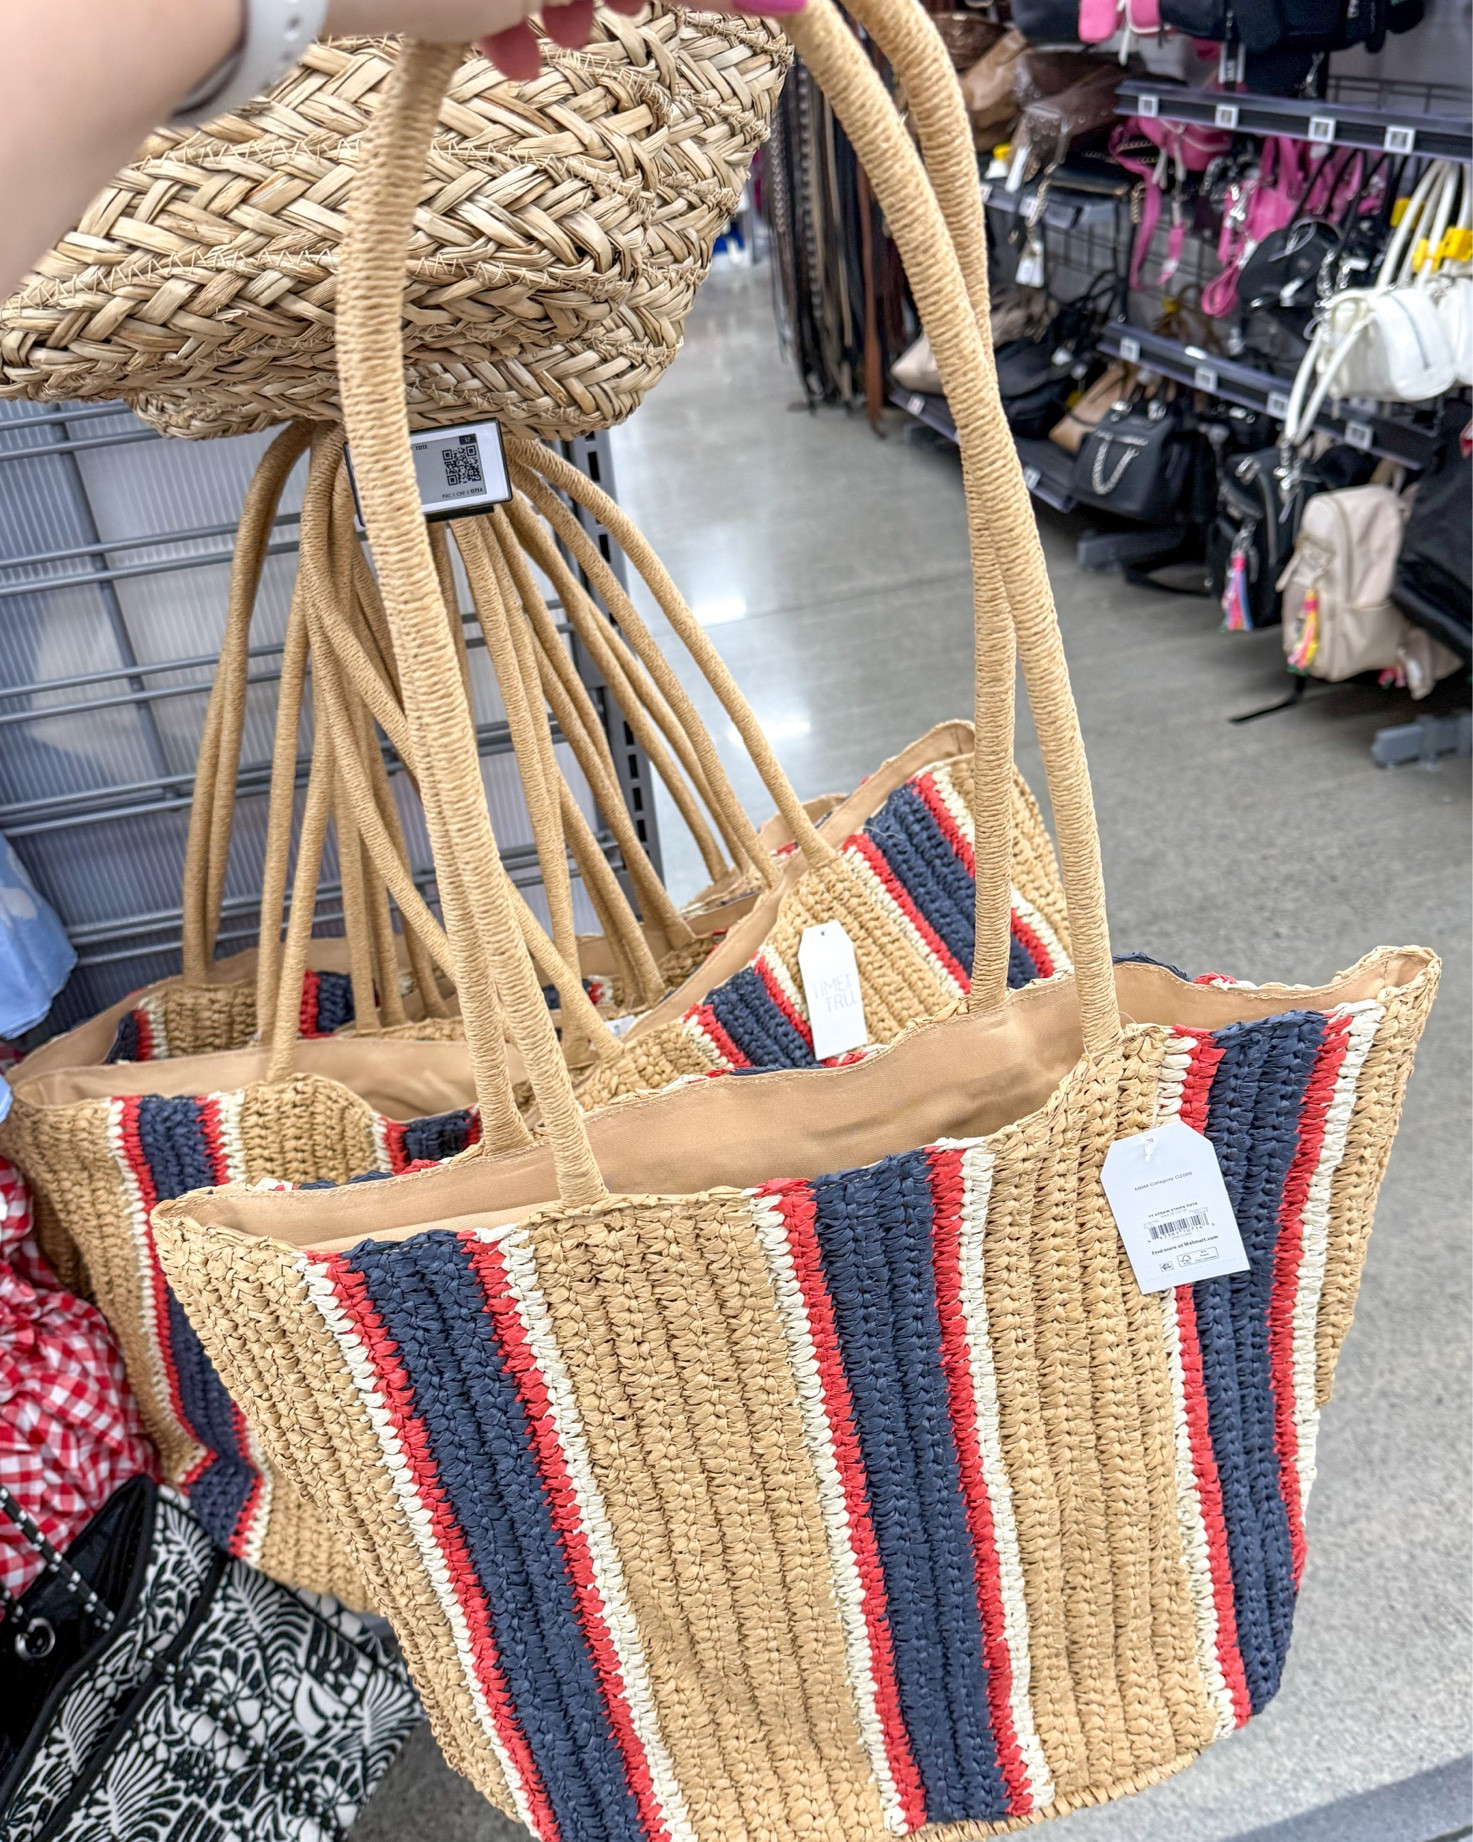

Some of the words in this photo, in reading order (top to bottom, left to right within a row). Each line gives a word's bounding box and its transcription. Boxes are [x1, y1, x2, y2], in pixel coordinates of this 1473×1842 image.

[1150, 1177, 1174, 1186] Category
[1151, 1248, 1163, 1256] Find
[1163, 1245, 1177, 1253] more
[1184, 1235, 1218, 1247] Walmart.com
